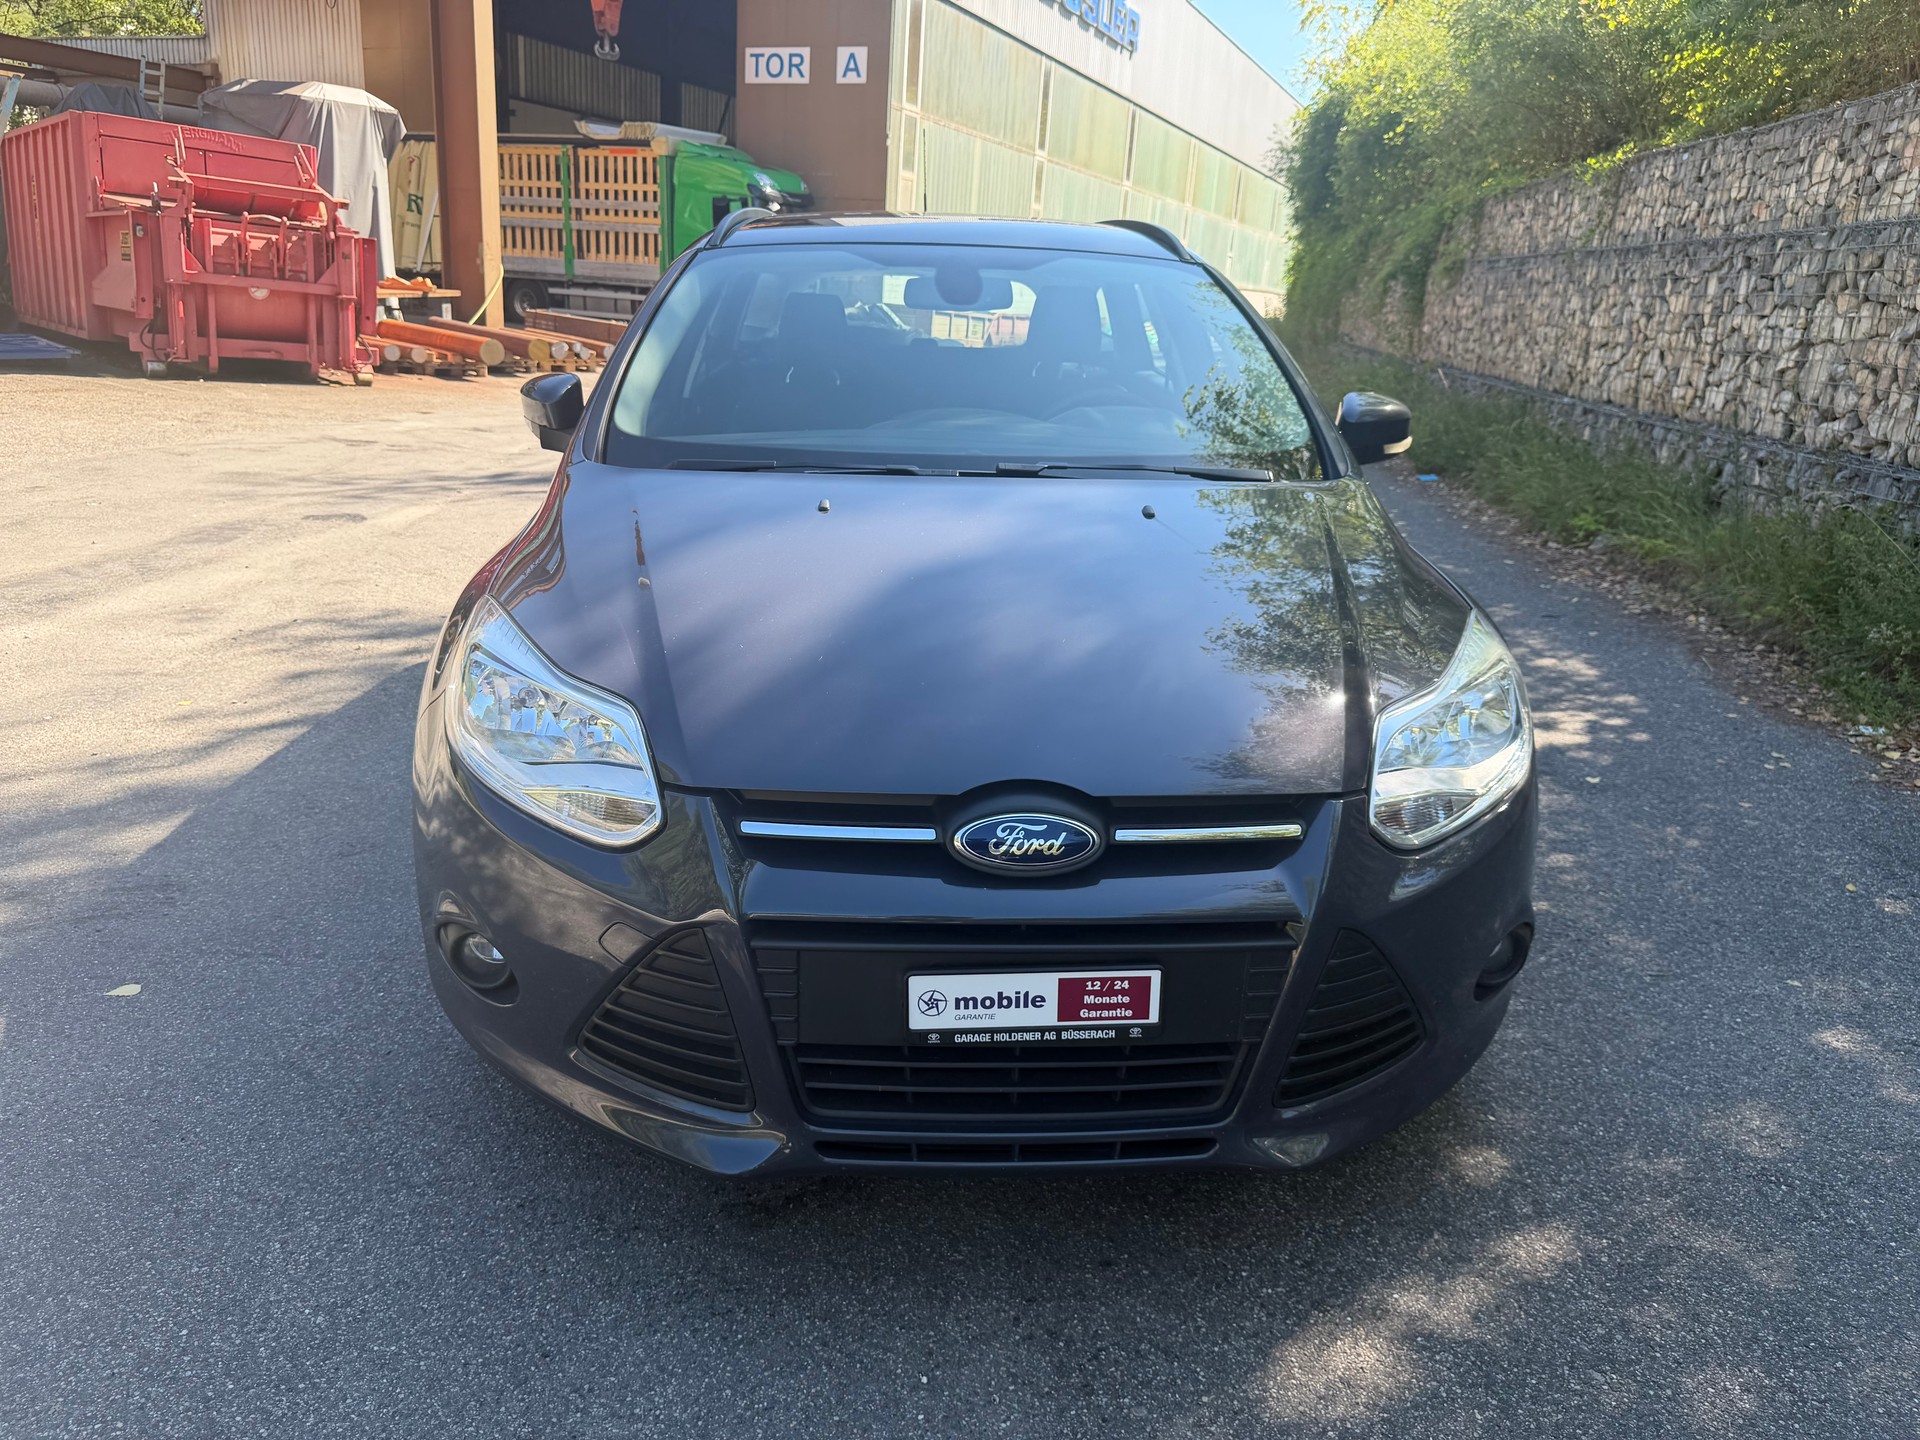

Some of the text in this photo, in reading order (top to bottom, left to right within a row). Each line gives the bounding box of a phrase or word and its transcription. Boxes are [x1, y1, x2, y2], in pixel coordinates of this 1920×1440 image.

[749, 52, 862, 79] TOR A
[988, 822, 1067, 856] Ford
[1085, 981, 1101, 990] 12
[1113, 980, 1130, 990] 24
[954, 990, 1047, 1011] mobile
[1083, 994, 1131, 1005] Monate
[954, 1013, 996, 1021] GARANTIE
[1079, 1007, 1134, 1019] Garantie
[954, 1029, 1116, 1043] GARAGE HOLDENER AG BÜSSERACH
